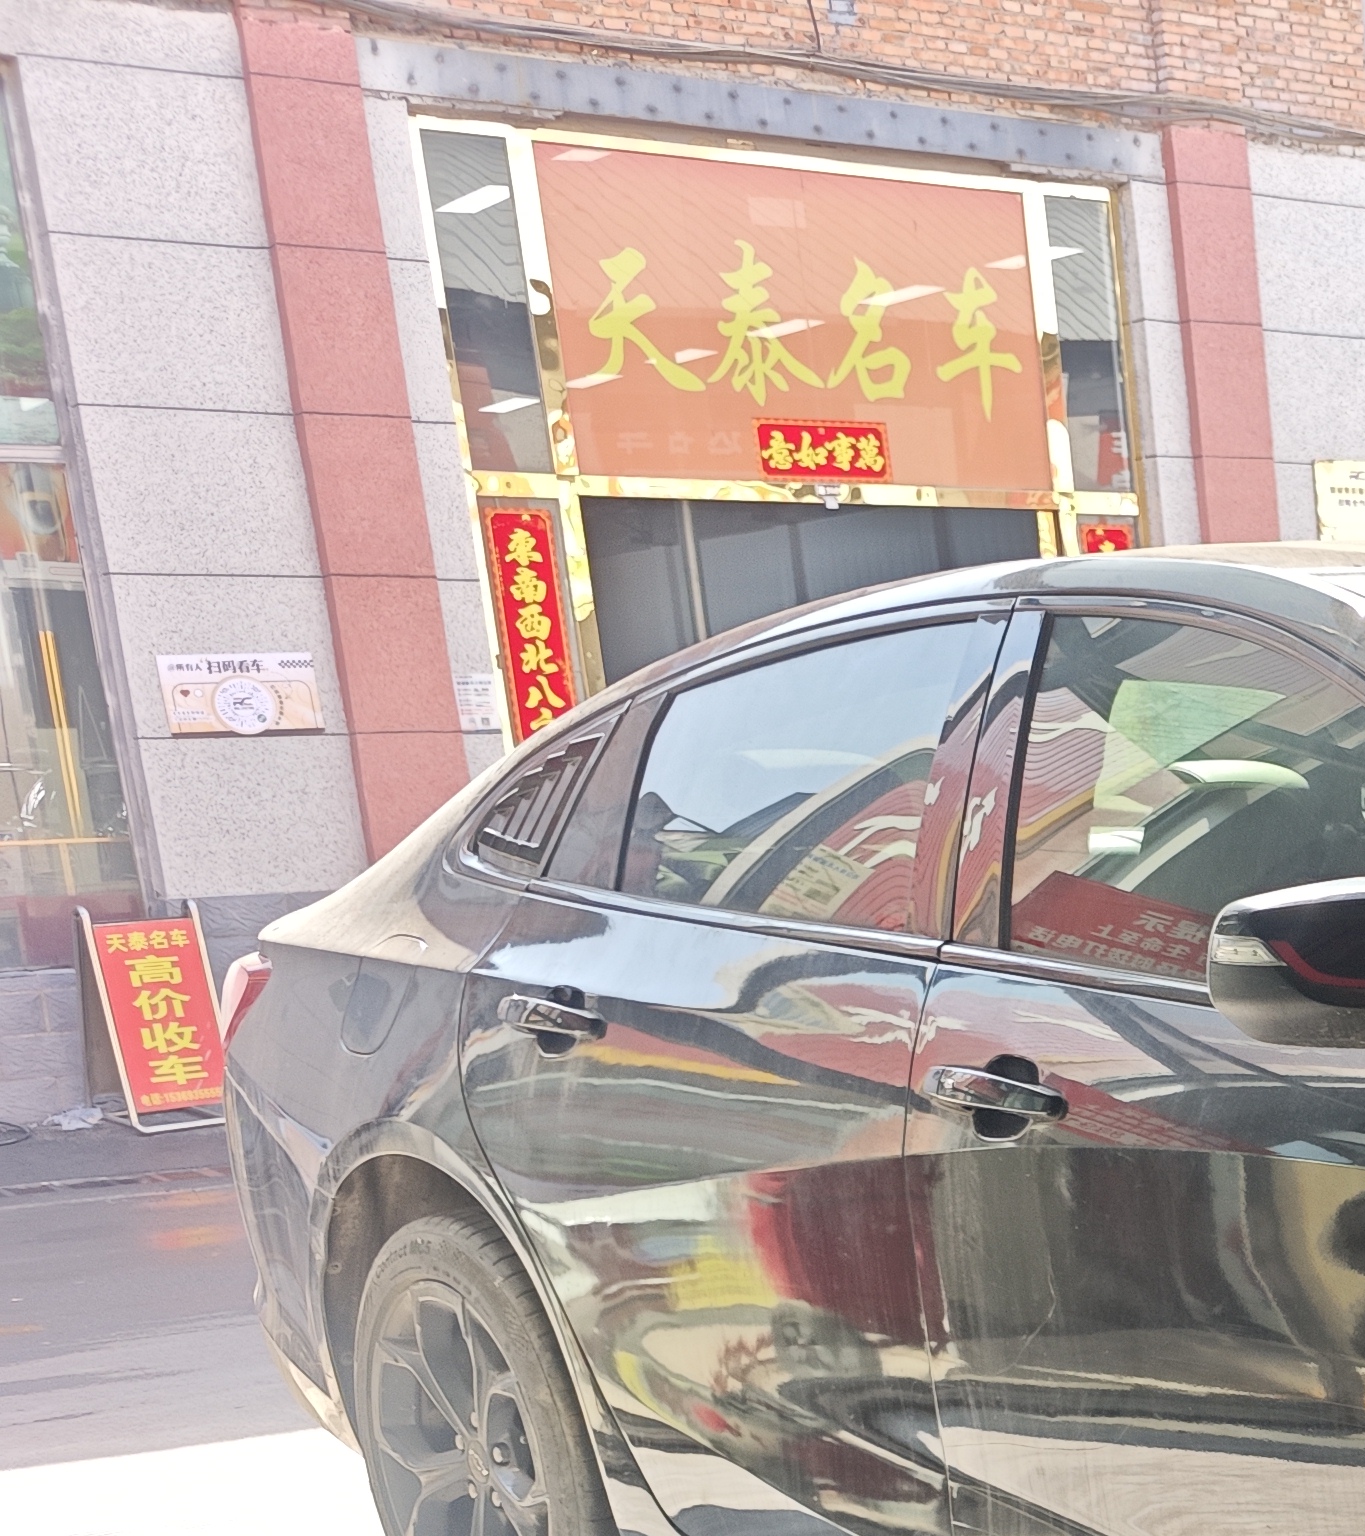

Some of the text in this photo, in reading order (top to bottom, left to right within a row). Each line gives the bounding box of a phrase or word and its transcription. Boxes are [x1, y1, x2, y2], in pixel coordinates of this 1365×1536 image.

[588, 239, 1023, 422] 天泰名车
[105, 928, 191, 954] 天泰名车
[124, 954, 210, 1086] 高价收车
